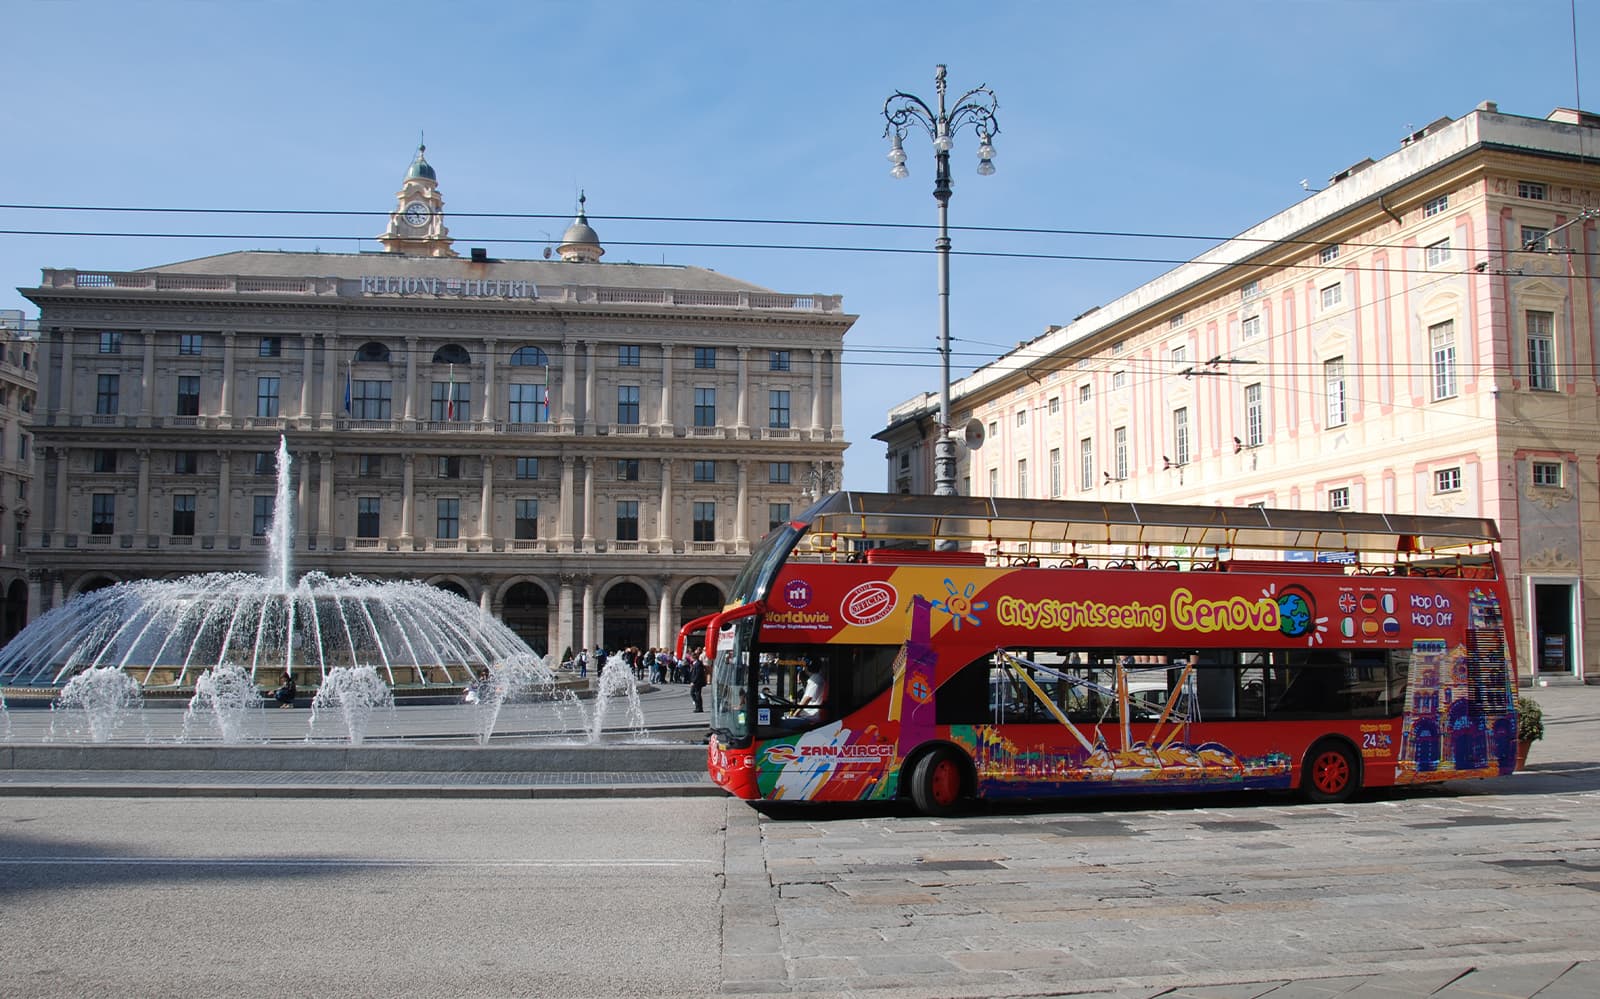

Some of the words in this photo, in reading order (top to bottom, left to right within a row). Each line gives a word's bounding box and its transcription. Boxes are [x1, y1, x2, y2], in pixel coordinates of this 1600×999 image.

[360, 276, 442, 295] REGIONE
[465, 280, 540, 298] LIGURIA
[852, 592, 887, 613] OFFICIAL
[1410, 595, 1432, 609] Hop
[1434, 594, 1450, 608] On
[997, 596, 1166, 632] CitySightseeing
[1170, 588, 1281, 632] Genova
[1411, 612, 1433, 627] Hop
[1436, 612, 1453, 626] Off
[1362, 733, 1377, 748] 24
[801, 746, 838, 756] ZANI
[841, 745, 893, 756] VIAGGI
